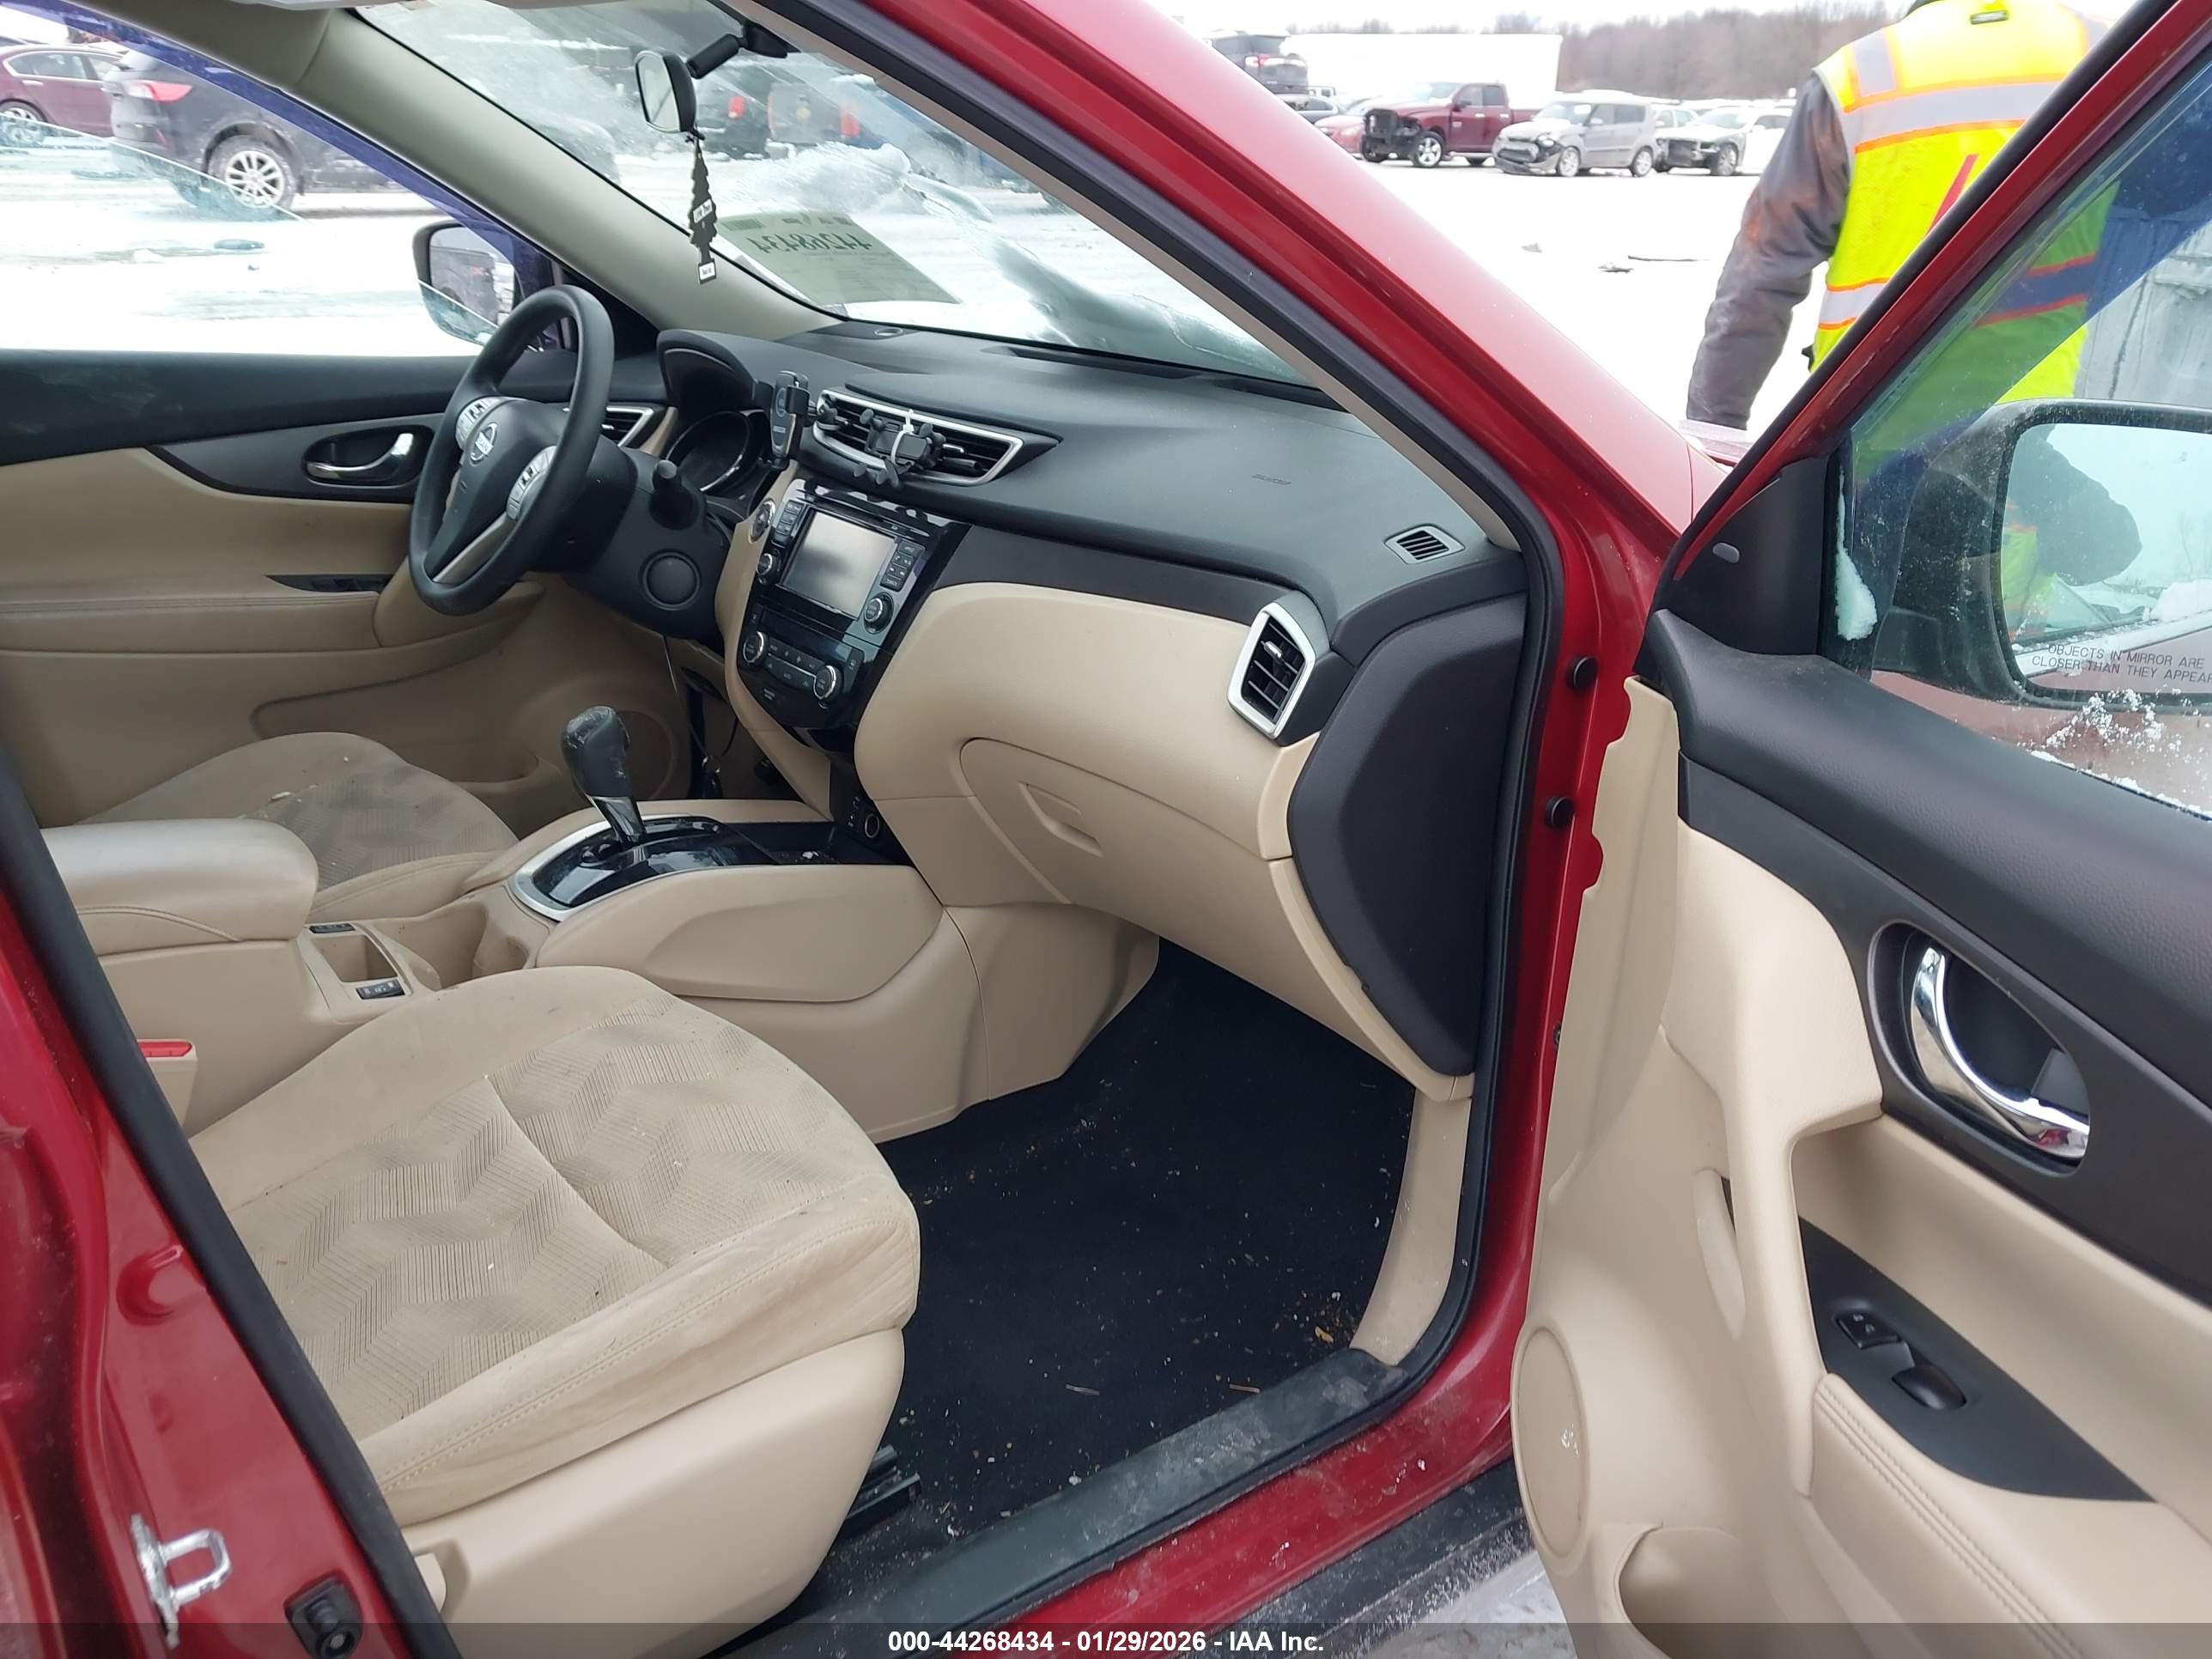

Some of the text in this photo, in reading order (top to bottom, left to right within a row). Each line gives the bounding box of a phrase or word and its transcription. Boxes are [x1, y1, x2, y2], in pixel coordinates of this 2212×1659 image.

[2032, 655, 2081, 671] CLOSER
[2086, 659, 2120, 674] THAN
[2127, 665, 2158, 678] THEY
[2047, 644, 2205, 670] OBJECTS IN MIRROR ARE
